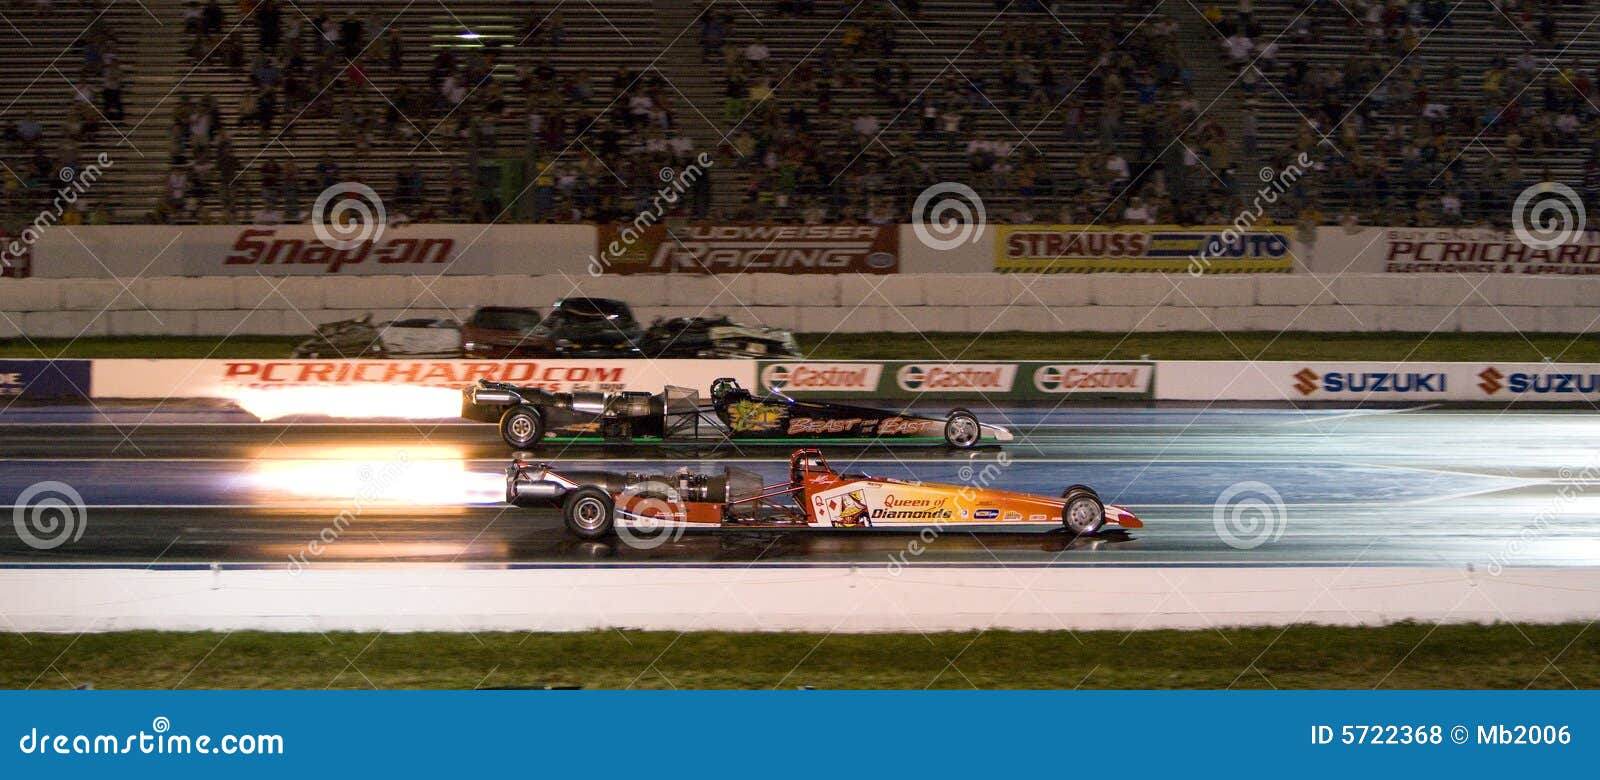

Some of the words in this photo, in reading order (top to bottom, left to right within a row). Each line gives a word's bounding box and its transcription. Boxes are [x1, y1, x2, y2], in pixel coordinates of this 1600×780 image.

[222, 229, 455, 273] Snap-on
[651, 242, 871, 268] RACING
[1008, 233, 1145, 256] STRAUSS
[1206, 233, 1290, 257] AUTO
[791, 366, 867, 387] Castrol
[926, 367, 1003, 388] Castrol
[1063, 368, 1138, 389] Castrol
[1323, 372, 1447, 392] SUZUKI
[884, 494, 929, 508] Queen
[934, 497, 949, 507] of
[871, 508, 952, 519] Diamonds
